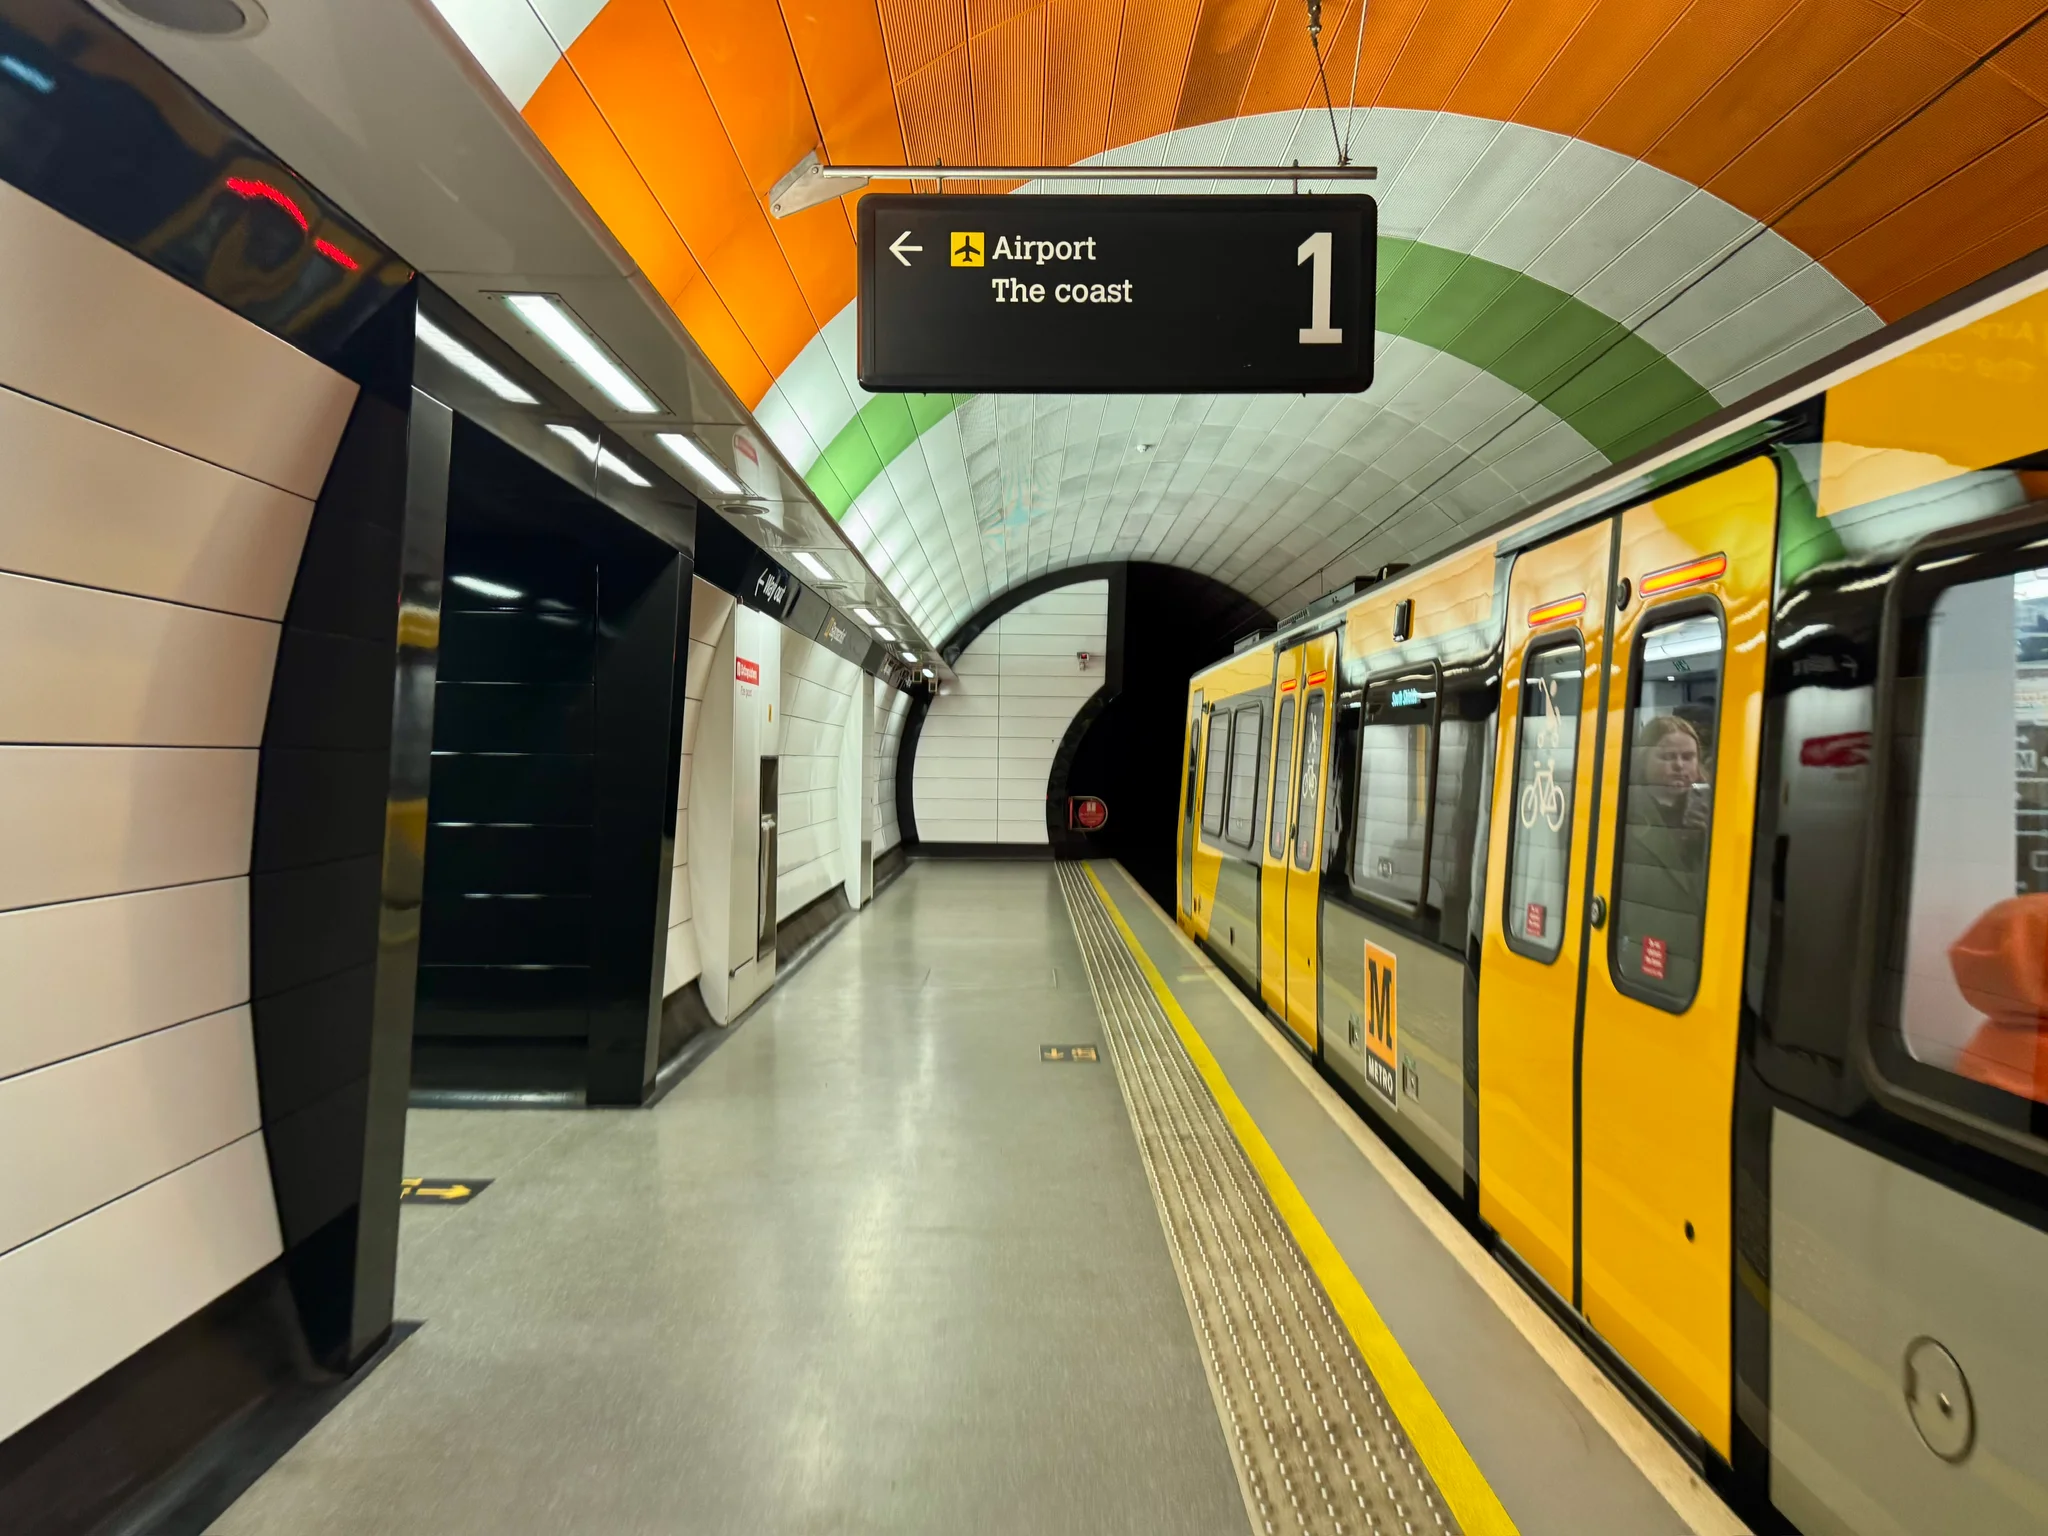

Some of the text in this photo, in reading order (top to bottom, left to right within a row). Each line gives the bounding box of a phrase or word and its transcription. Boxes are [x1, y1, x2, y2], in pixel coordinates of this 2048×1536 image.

[992, 235, 1096, 265] Airport
[992, 277, 1133, 303] The coast
[1297, 232, 1342, 344] 1
[763, 573, 786, 604] Way out
[1368, 957, 1393, 1051] M
[1368, 1054, 1393, 1096] METRO
